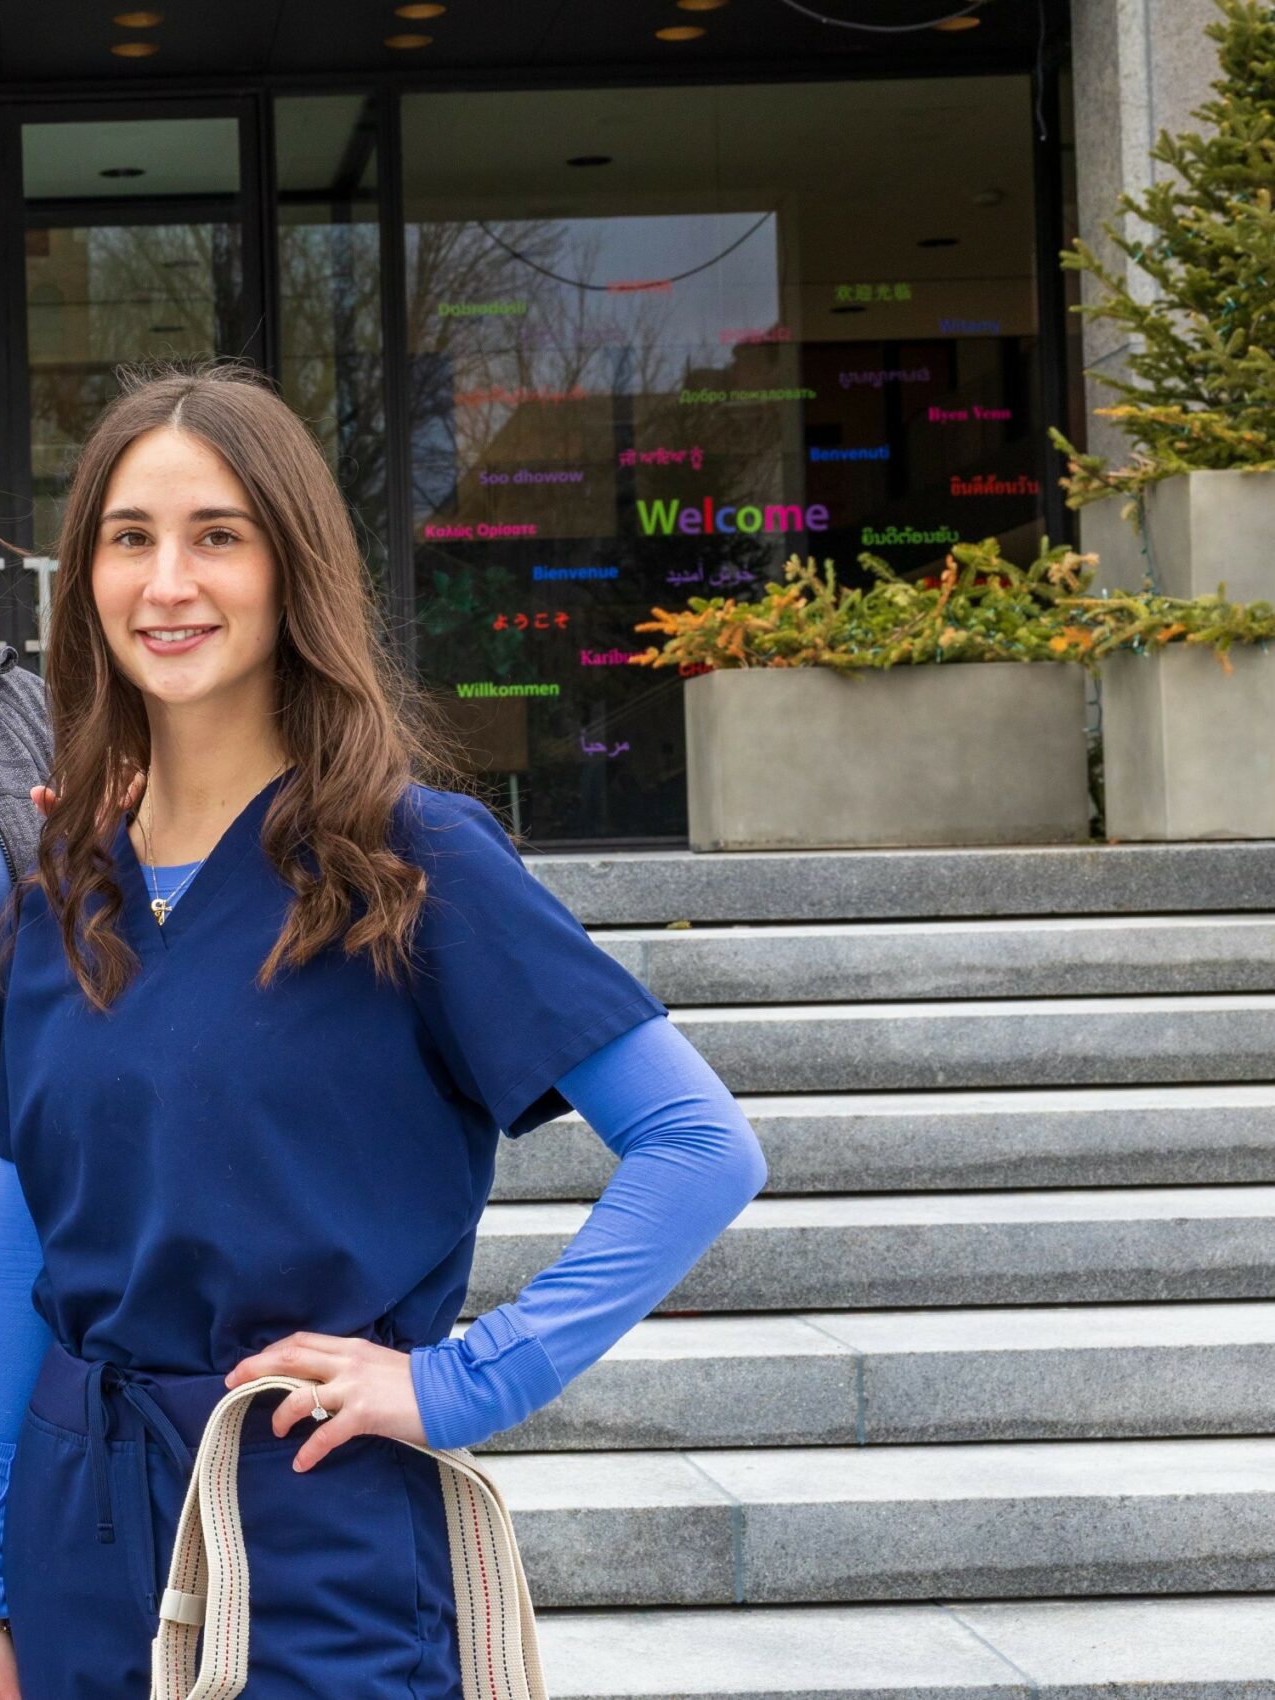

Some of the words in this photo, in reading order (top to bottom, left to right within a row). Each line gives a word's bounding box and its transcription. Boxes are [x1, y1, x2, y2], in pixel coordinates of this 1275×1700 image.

[479, 470, 510, 486] Soo
[636, 497, 829, 536] Welcome
[532, 565, 619, 581] Bienvenue
[492, 612, 571, 631] ようこそ
[457, 682, 560, 699] Willkommen
